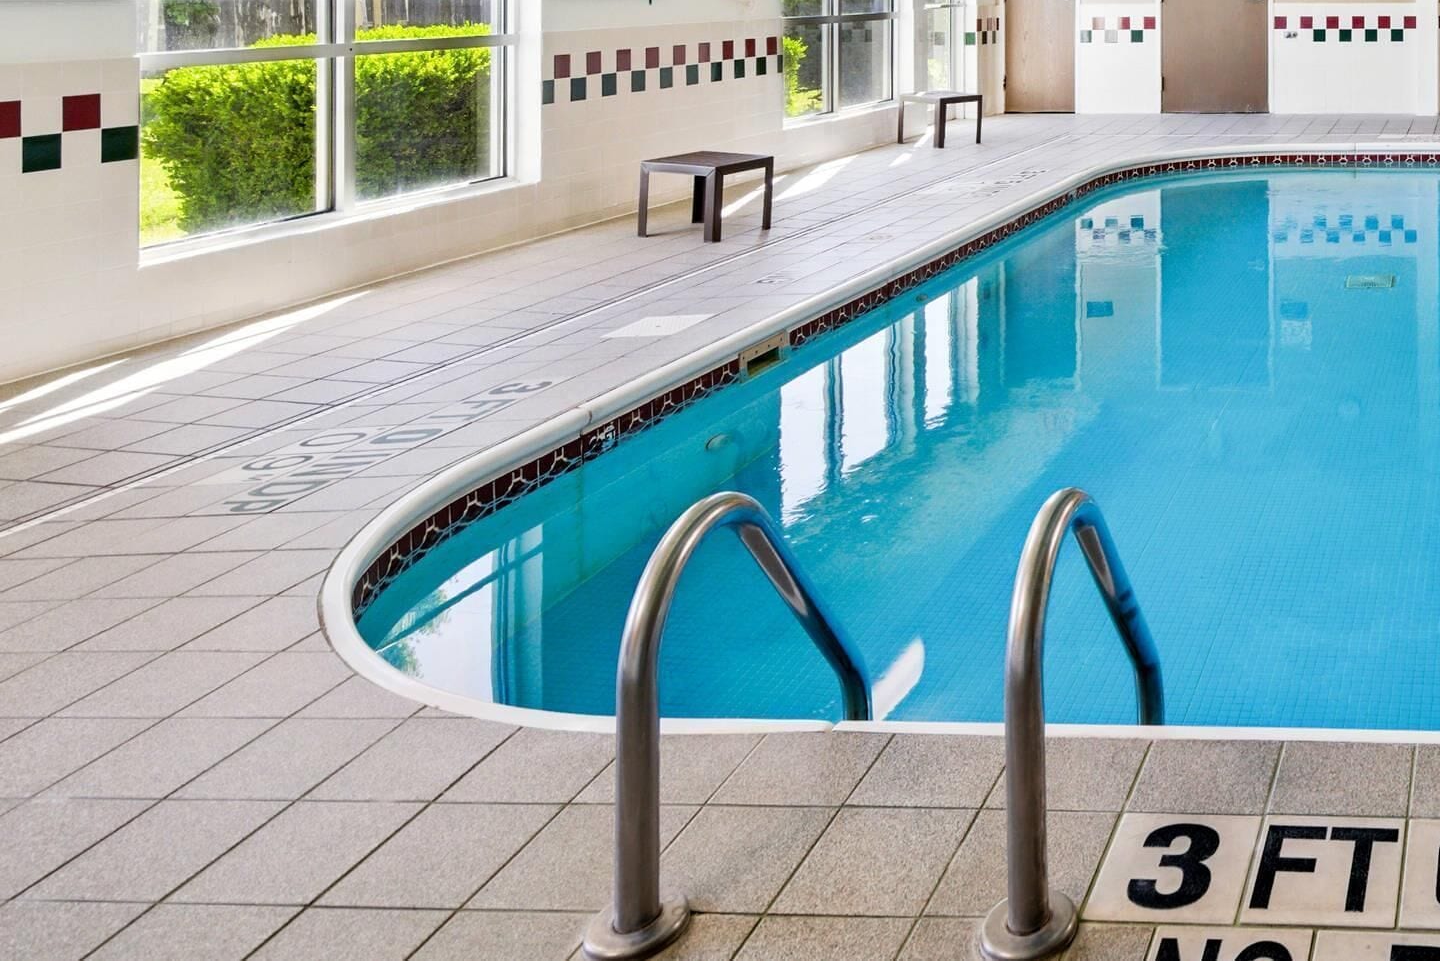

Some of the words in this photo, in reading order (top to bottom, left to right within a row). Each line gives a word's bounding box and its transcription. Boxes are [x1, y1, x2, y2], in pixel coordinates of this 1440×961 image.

[488, 381, 553, 395] 3
[427, 399, 518, 421] FT
[1126, 821, 1222, 911] 3
[1248, 823, 1400, 914] FT
